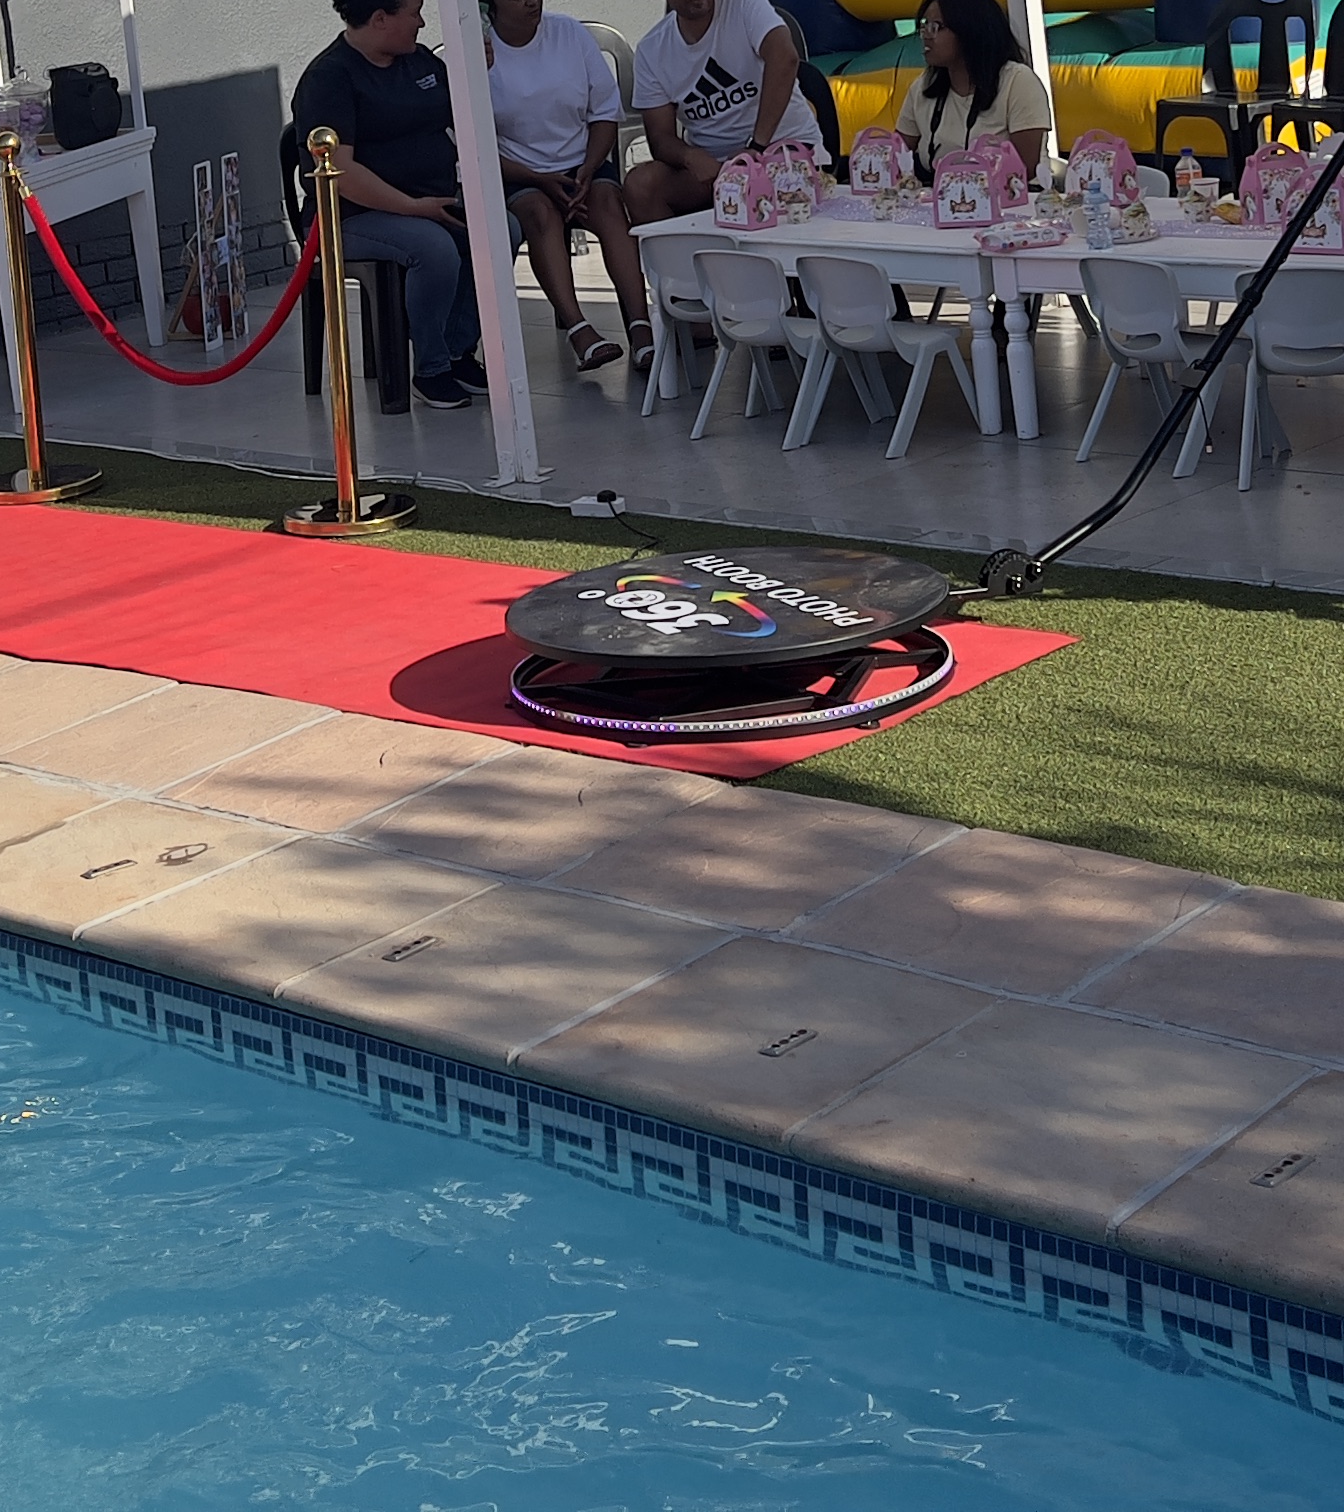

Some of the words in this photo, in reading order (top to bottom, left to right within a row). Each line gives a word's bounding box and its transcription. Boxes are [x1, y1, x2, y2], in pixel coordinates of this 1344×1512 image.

[683, 81, 759, 121] adidas
[682, 554, 786, 591] BOOTH
[766, 587, 875, 628] PHOTO
